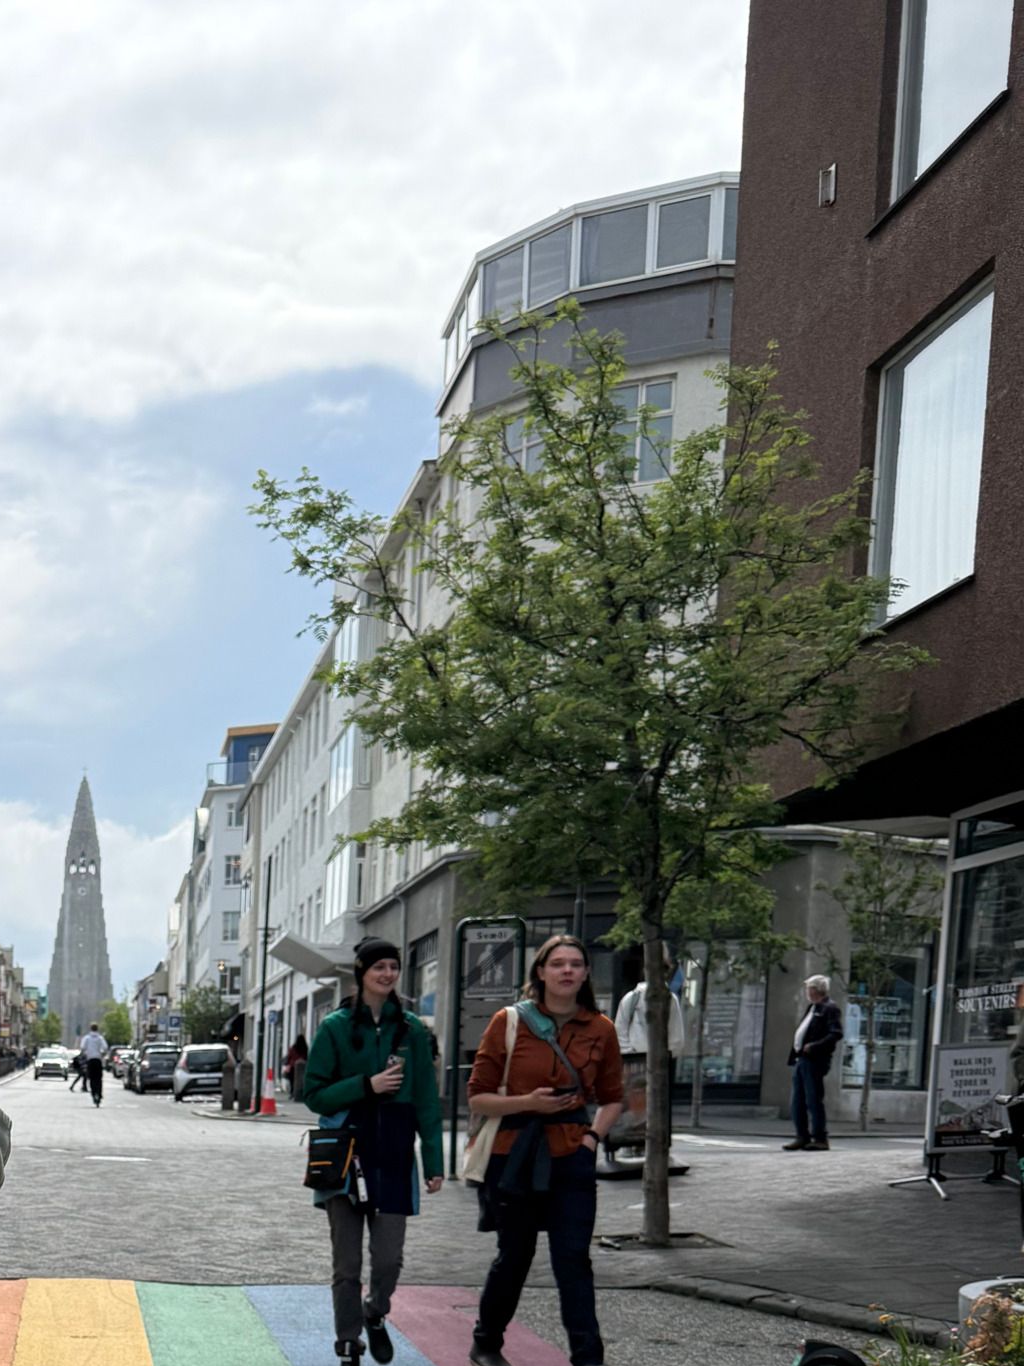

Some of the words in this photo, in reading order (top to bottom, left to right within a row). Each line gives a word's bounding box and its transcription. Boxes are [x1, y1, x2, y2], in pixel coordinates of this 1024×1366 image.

[956, 993, 1017, 1013] SOUVENIRS
[975, 1057, 992, 1066] INTO
[954, 1078, 978, 1088] STORE
